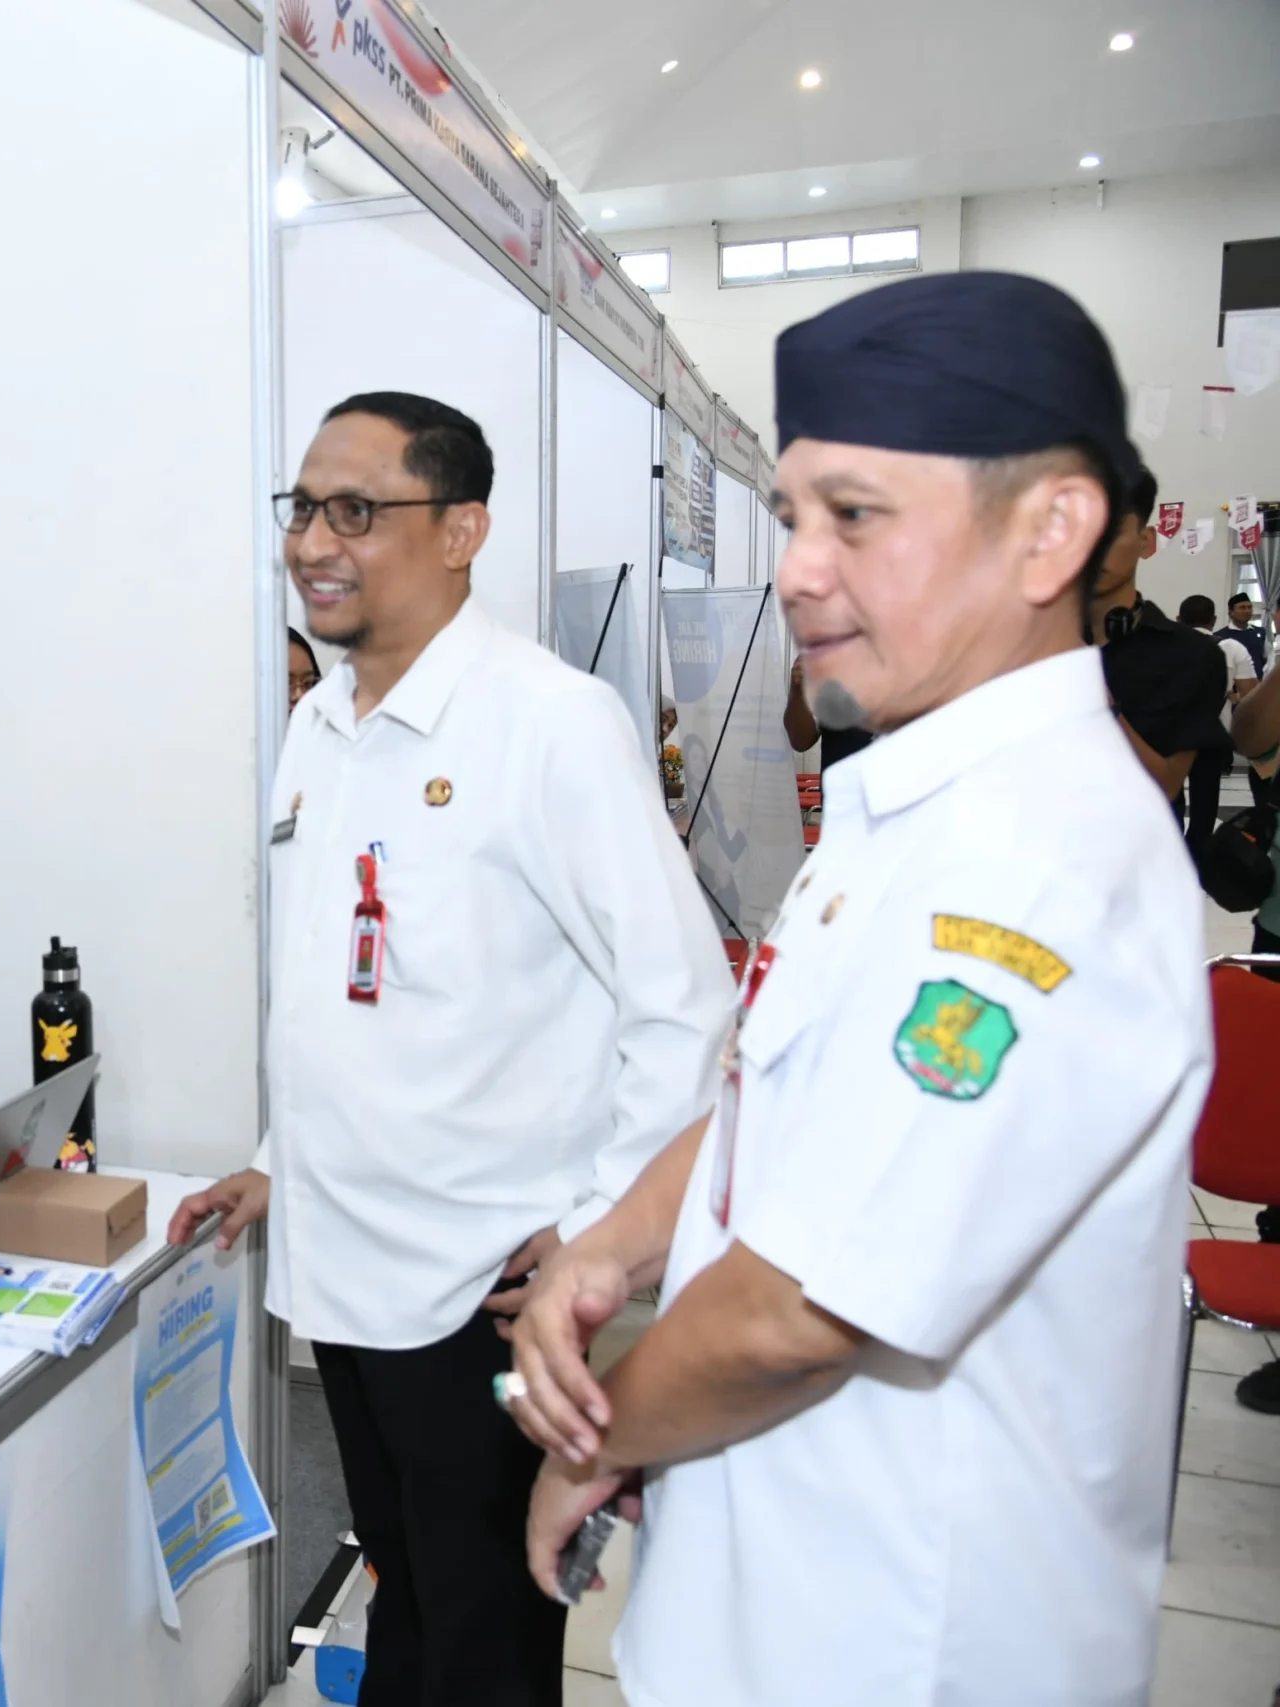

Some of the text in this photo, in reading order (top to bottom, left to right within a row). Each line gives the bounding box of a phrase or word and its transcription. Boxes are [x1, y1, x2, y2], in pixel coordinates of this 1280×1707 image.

[353, 17, 386, 76] pkss
[405, 80, 432, 128] PRIMA
[159, 1285, 214, 1349] HIRING
